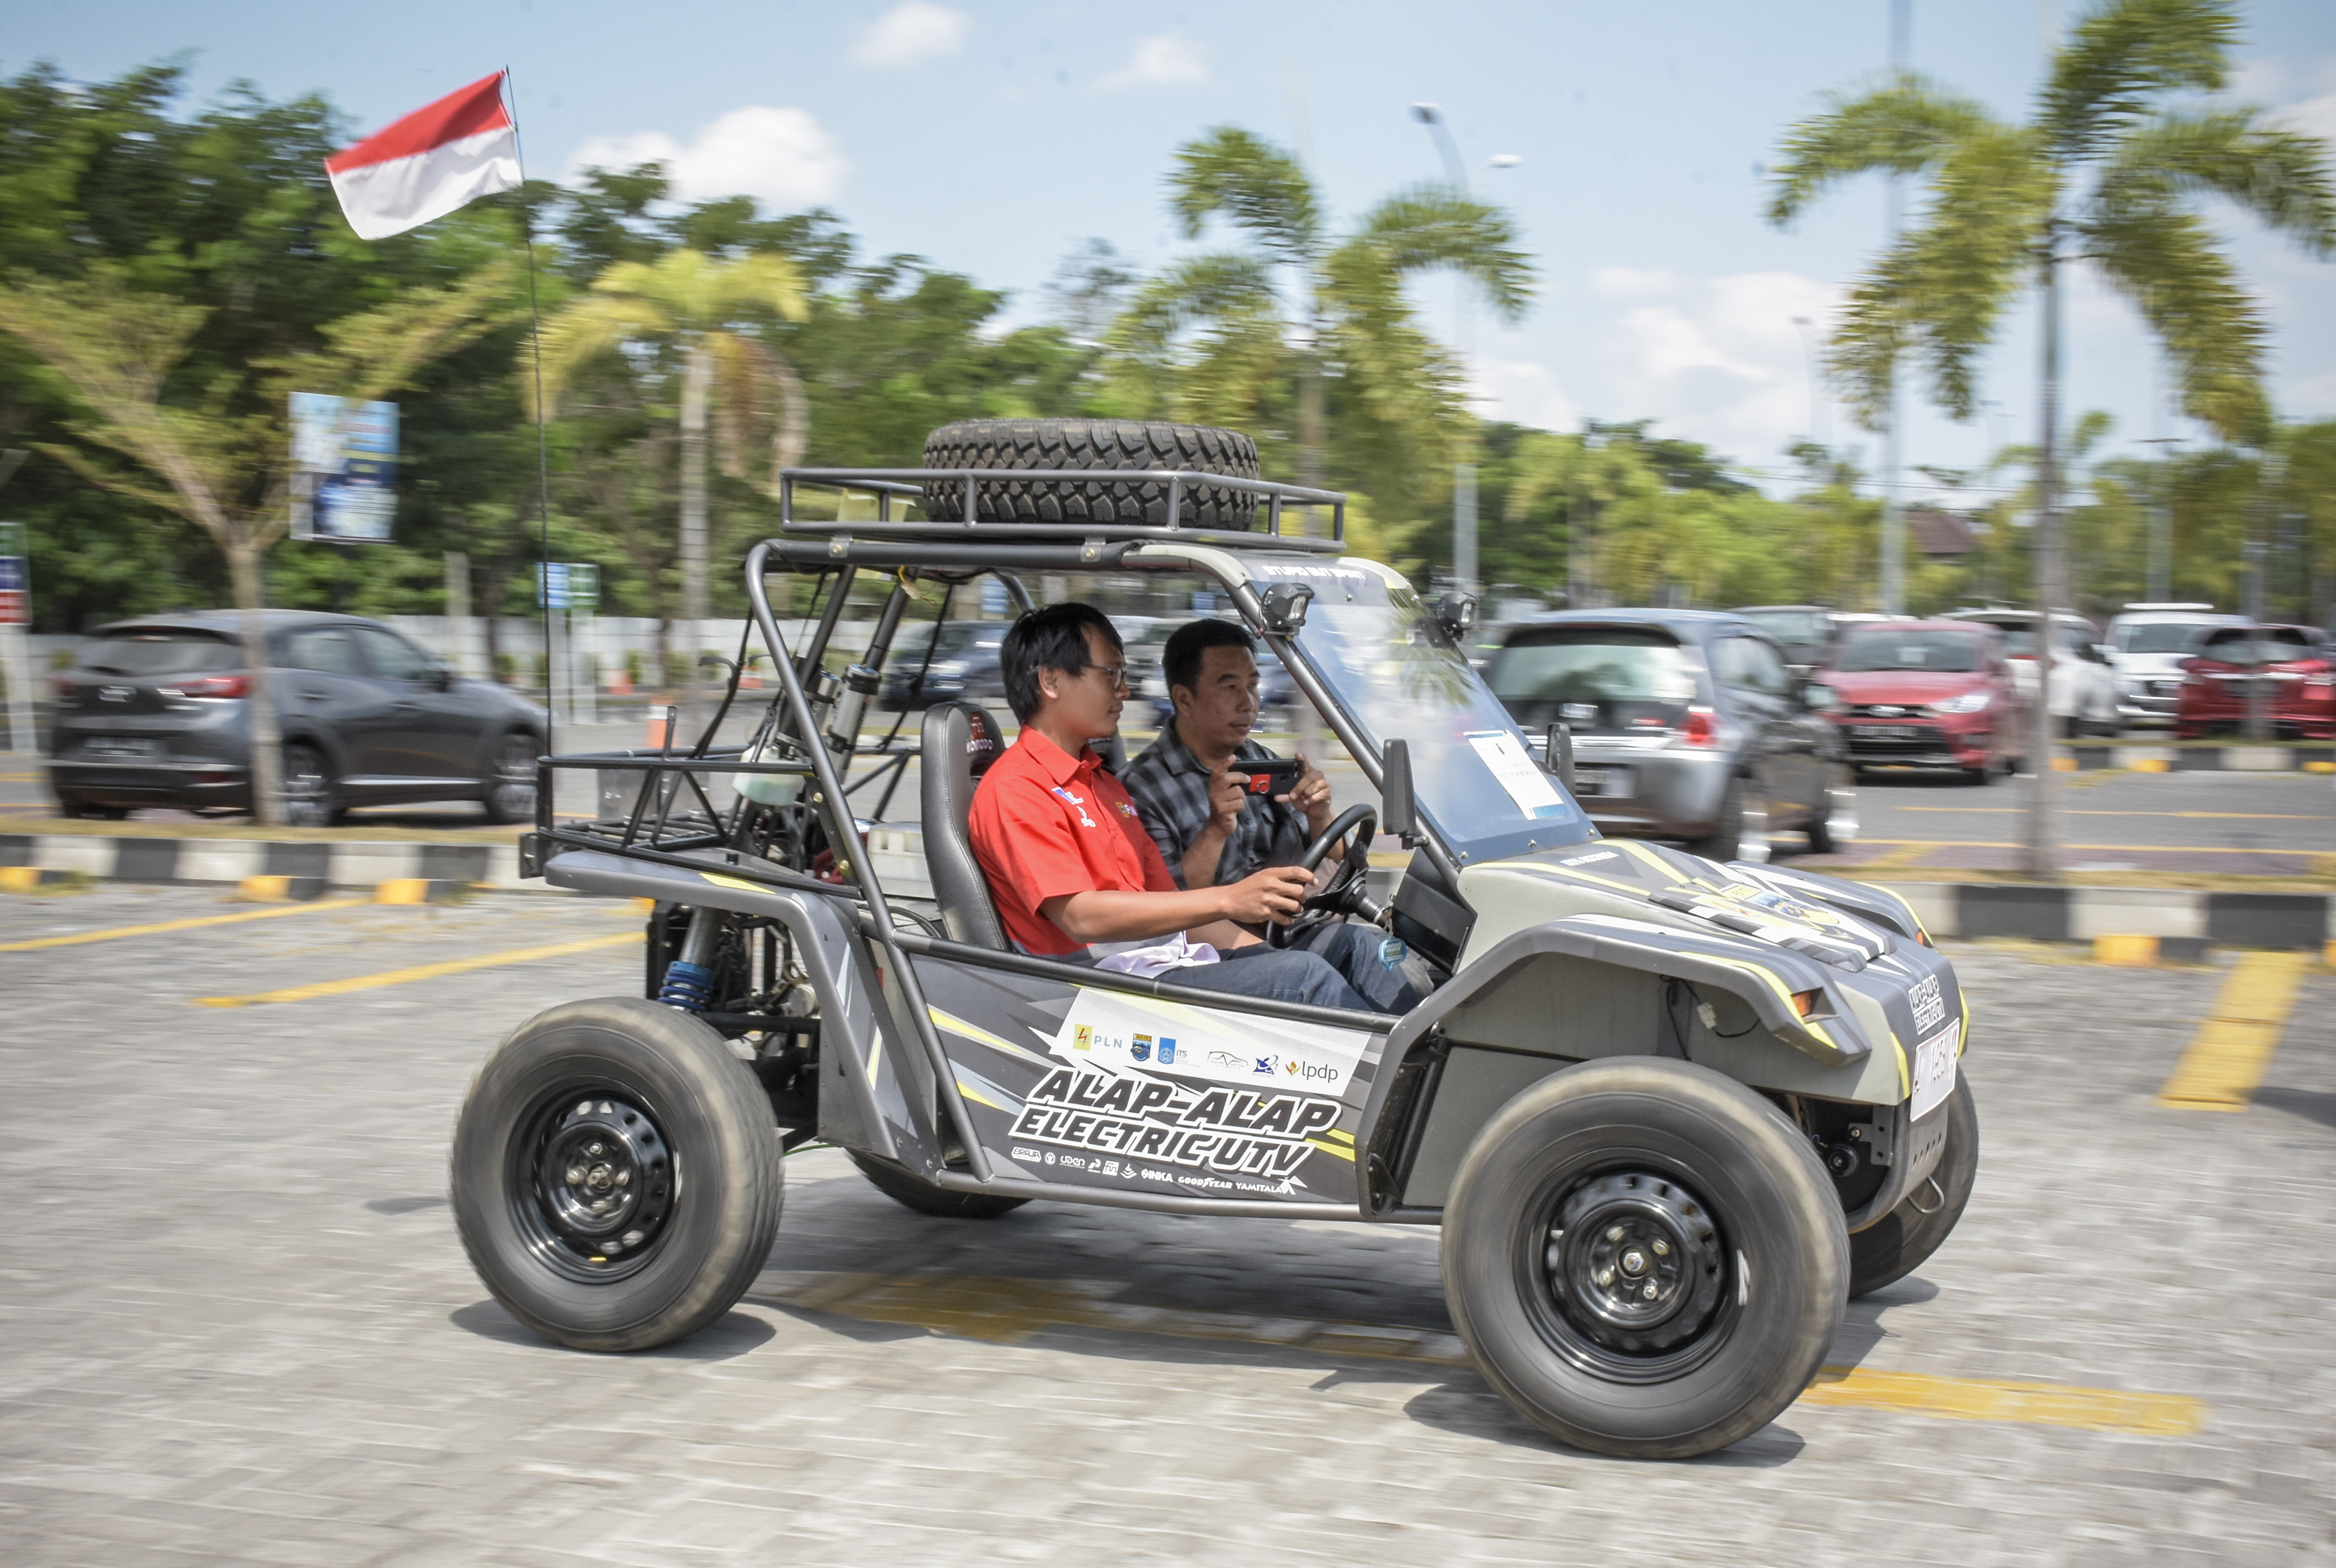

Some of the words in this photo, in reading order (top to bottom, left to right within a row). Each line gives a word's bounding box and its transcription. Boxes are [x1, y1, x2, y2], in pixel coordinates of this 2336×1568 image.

[1094, 1035, 1123, 1049] PLN
[1302, 1061, 1338, 1083] lpdp
[1028, 1067, 1342, 1137] ALAP-ALAP
[1178, 1176, 1233, 1189] GOODYEAR
